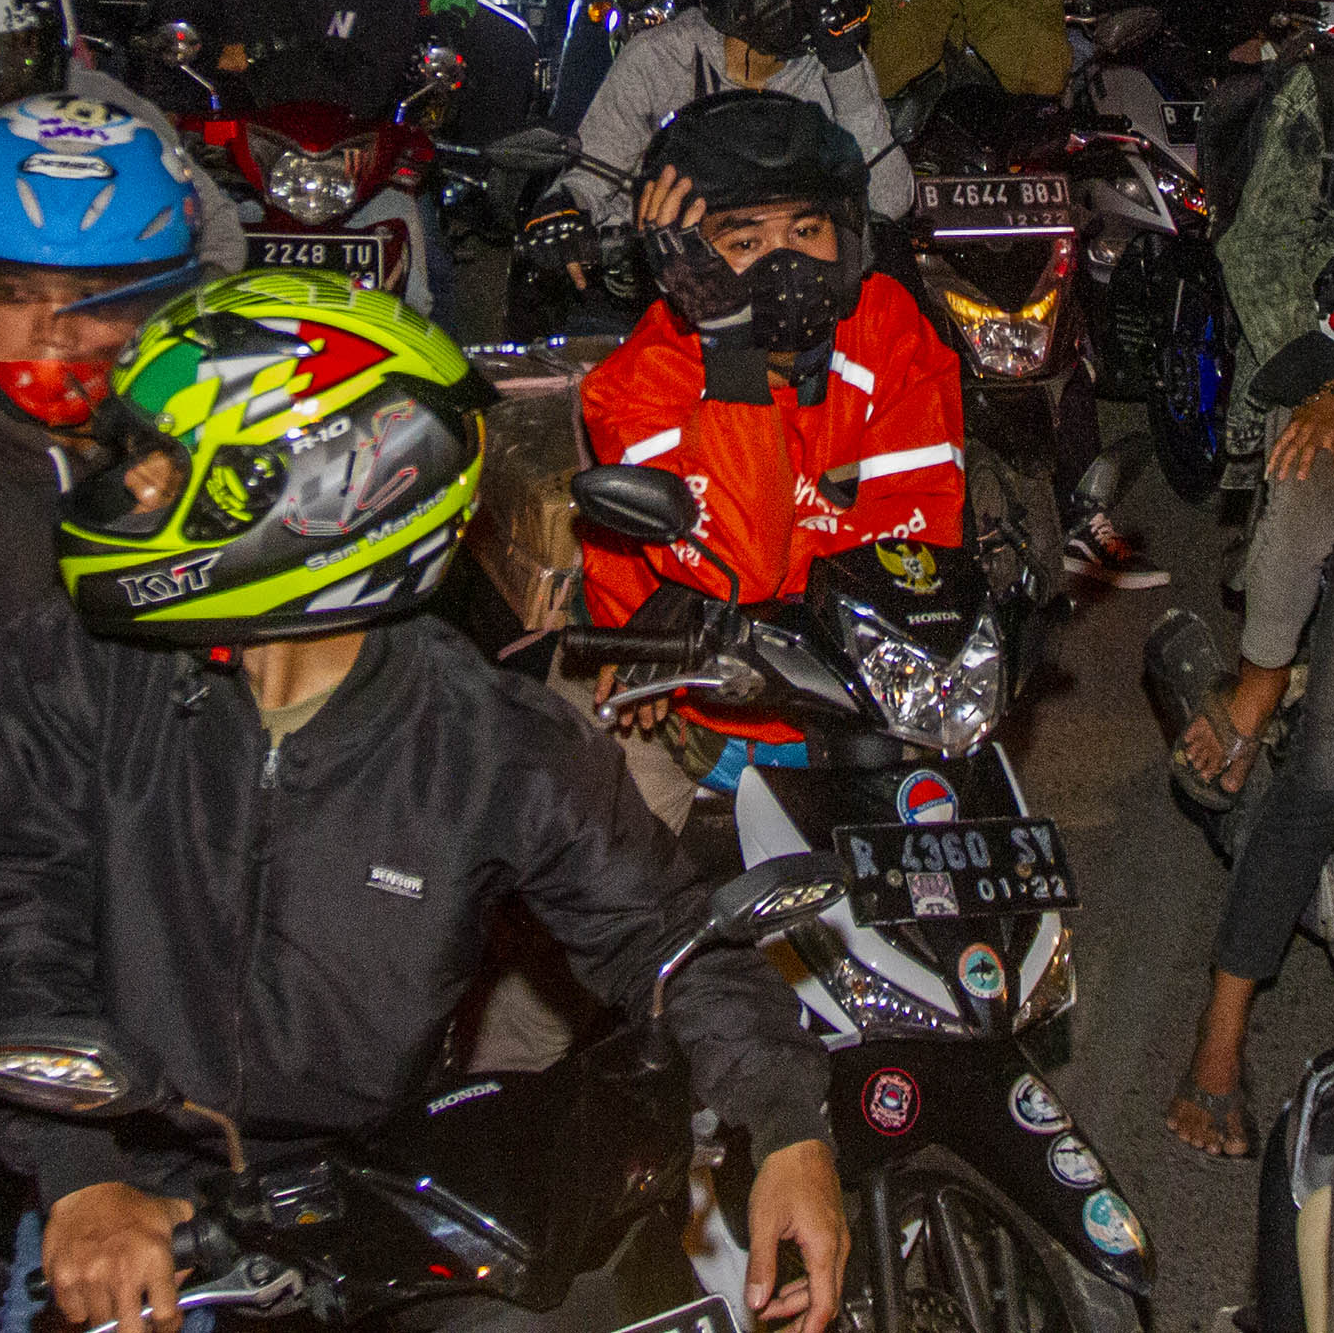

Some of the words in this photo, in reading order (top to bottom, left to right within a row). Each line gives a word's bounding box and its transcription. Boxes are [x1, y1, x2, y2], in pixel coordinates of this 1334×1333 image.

[924, 185, 939, 207] B
[953, 183, 1009, 206] 4644
[264, 241, 326, 264] 2248
[341, 243, 372, 265] TU
[304, 543, 361, 573] San
[365, 487, 451, 546] Marino
[118, 549, 225, 607] KYT
[907, 611, 962, 626] HONDA
[426, 1082, 504, 1115] HONDA
